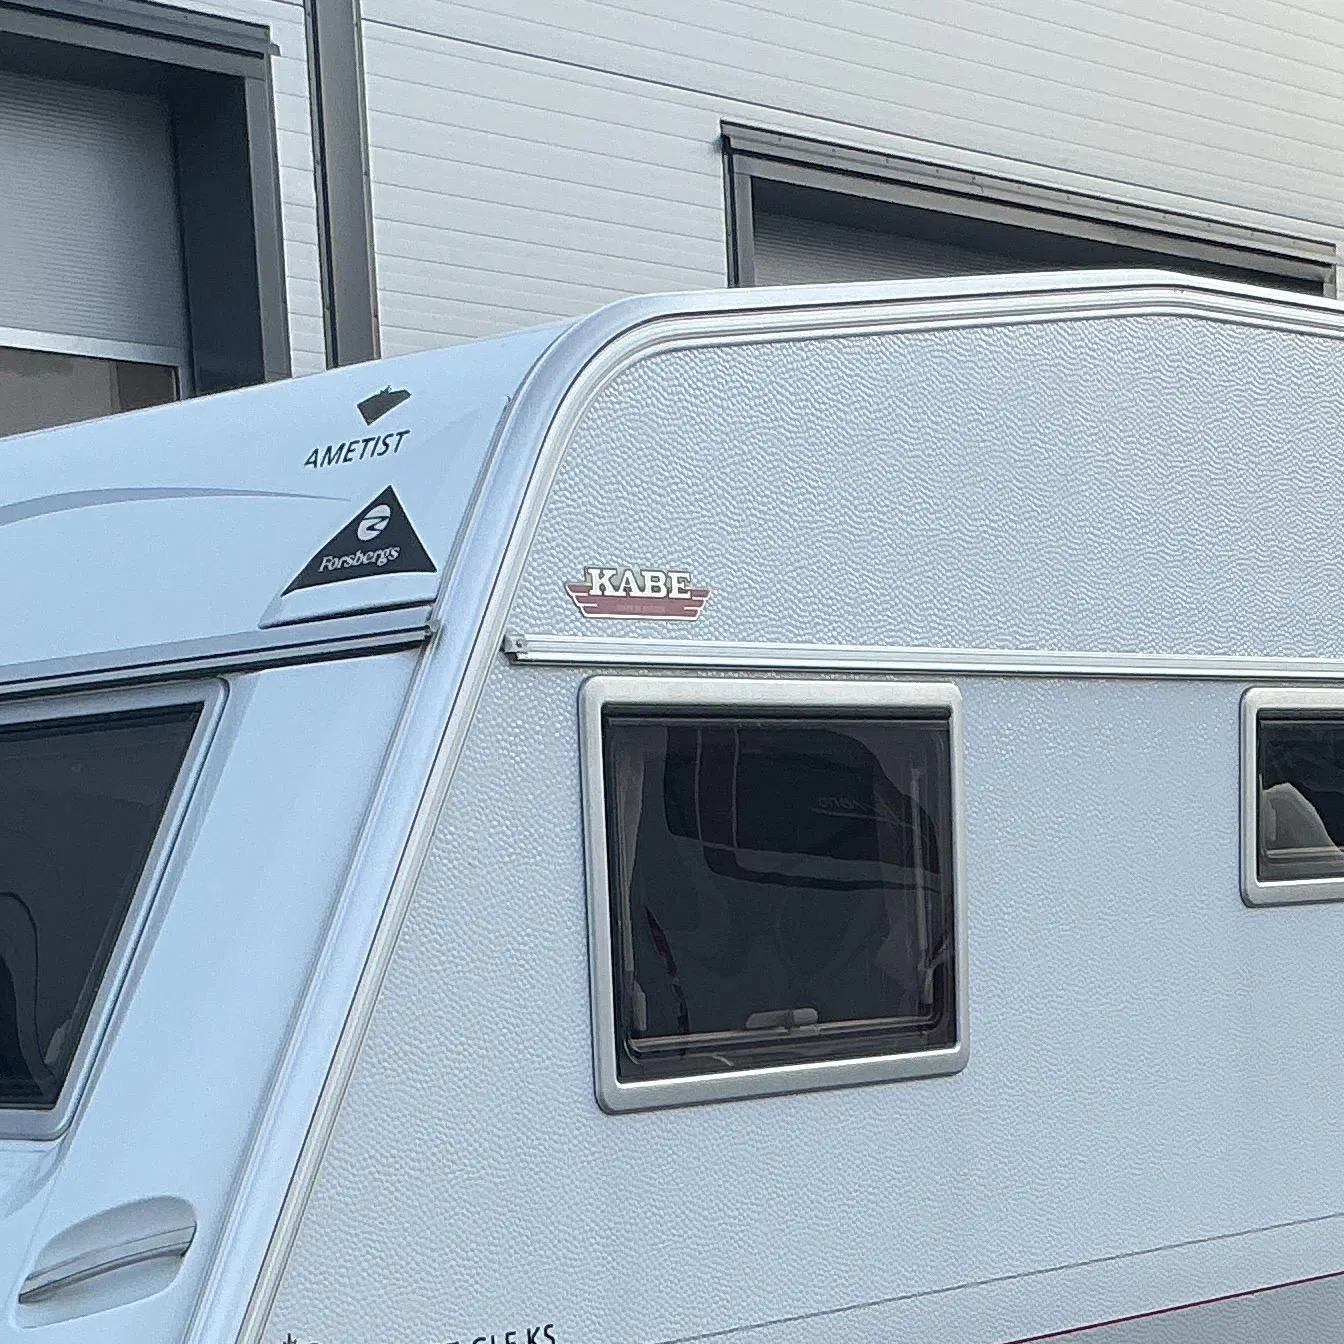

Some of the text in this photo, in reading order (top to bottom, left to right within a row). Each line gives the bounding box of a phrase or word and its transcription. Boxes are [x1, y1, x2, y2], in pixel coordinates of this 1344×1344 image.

[303, 429, 411, 469] AMETIST
[317, 545, 401, 574] Forsbergs
[584, 566, 694, 600] KABE
